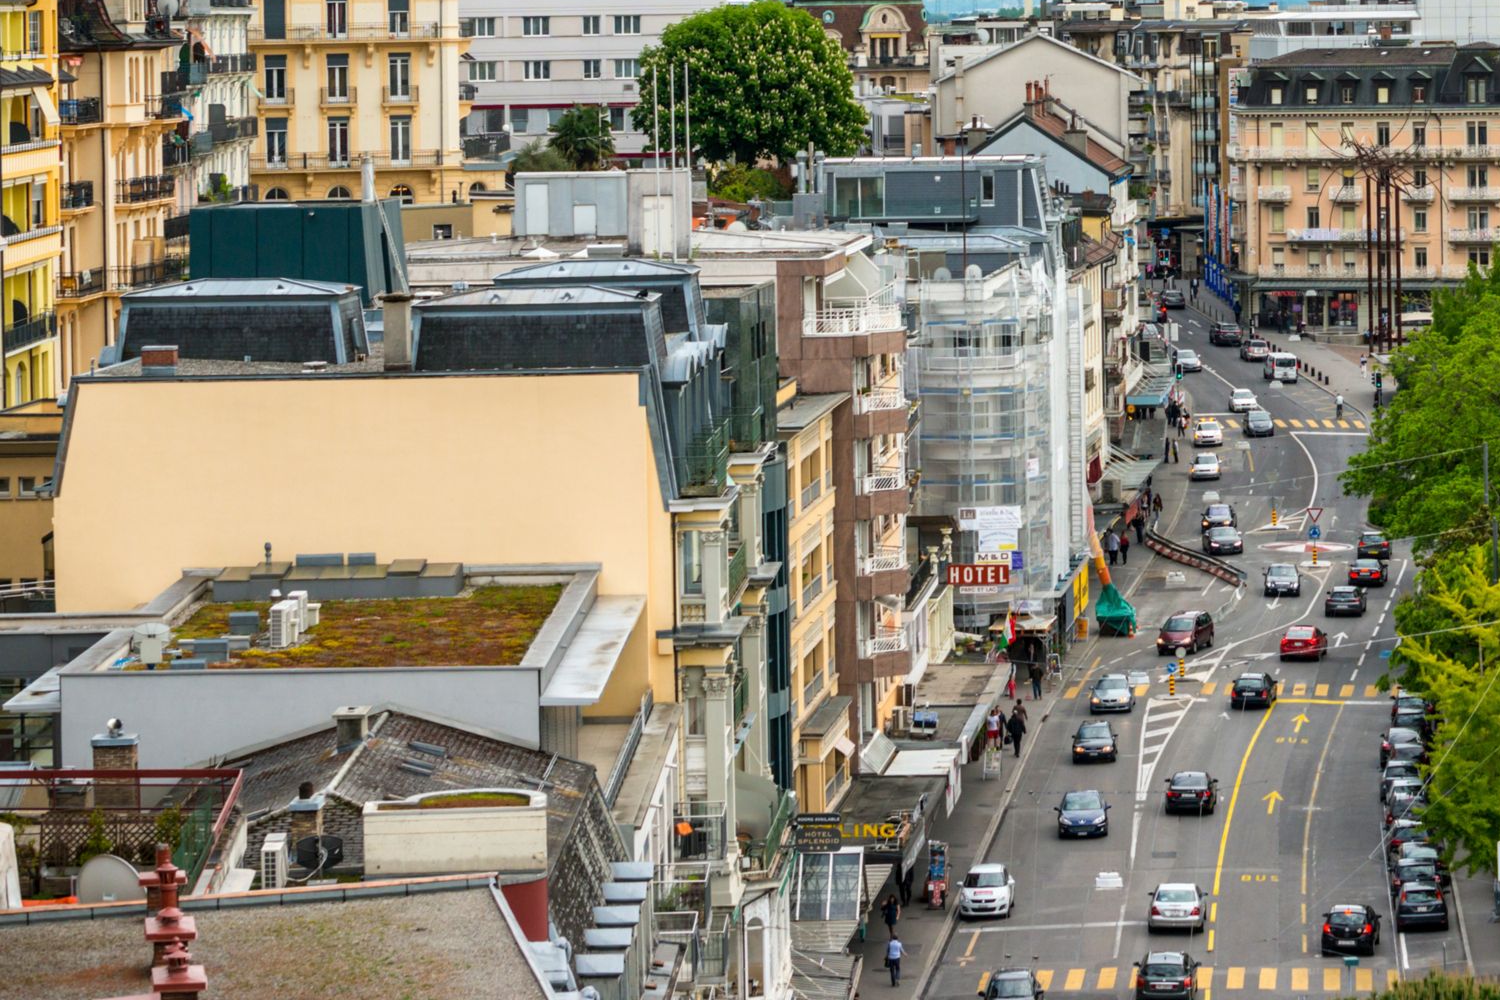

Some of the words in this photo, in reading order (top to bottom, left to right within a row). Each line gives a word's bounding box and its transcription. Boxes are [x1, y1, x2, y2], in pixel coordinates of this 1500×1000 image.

[950, 567, 1007, 583] HOTEL
[1275, 736, 1309, 744] BUS
[1240, 874, 1279, 882] BUS
